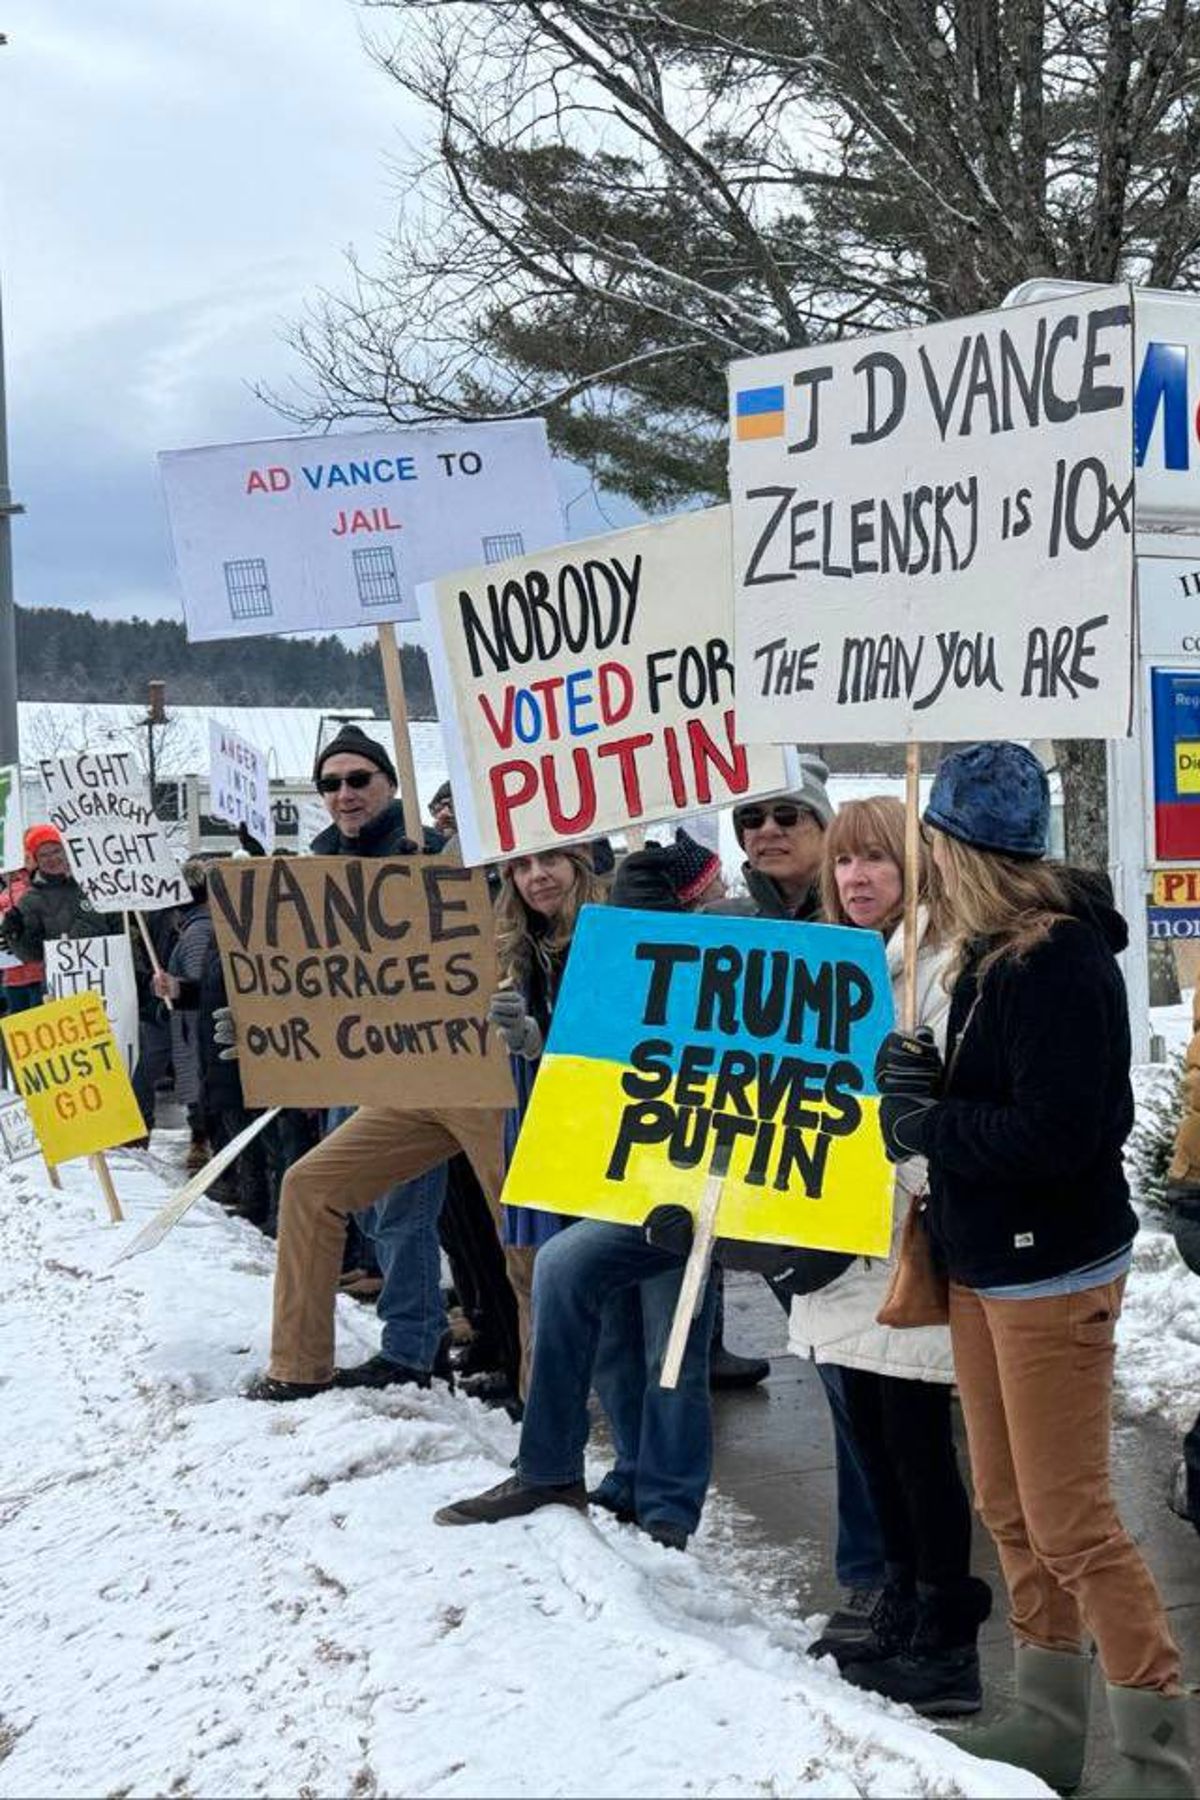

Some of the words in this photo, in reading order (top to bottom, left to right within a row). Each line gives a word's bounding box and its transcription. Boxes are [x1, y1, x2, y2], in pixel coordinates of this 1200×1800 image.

[788, 366, 833, 454] J
[851, 351, 907, 445] D
[918, 305, 1132, 442] VANCE
[246, 467, 291, 495] AD
[302, 456, 418, 490] VANCE
[437, 450, 482, 477] TO
[331, 507, 403, 536] JAIL
[744, 476, 978, 587] ZELENSKY
[458, 554, 643, 678] NOBODY
[754, 637, 820, 697] THE
[837, 633, 924, 704] MAN
[913, 630, 1004, 711] YOU
[1021, 614, 1109, 700] ARE
[478, 661, 634, 750] VOTED
[646, 638, 736, 715] FOR
[39, 752, 129, 793] FIGHT
[226, 765, 258, 802] INTO
[488, 710, 750, 852] PUTIN
[50, 791, 156, 833] OLIGARCHY
[67, 832, 159, 868] FIGHT
[206, 858, 481, 953] VANCE
[56, 938, 110, 972] SKI
[229, 951, 479, 999] DISGRACES
[635, 942, 875, 1054] TRUMP
[246, 1017, 321, 1062] OUR
[336, 1014, 491, 1060] COUNTRY
[20, 1041, 113, 1096] MUST
[621, 1038, 864, 1137] SERVES
[55, 1083, 103, 1120] GO
[605, 1099, 832, 1200] PUTIN
